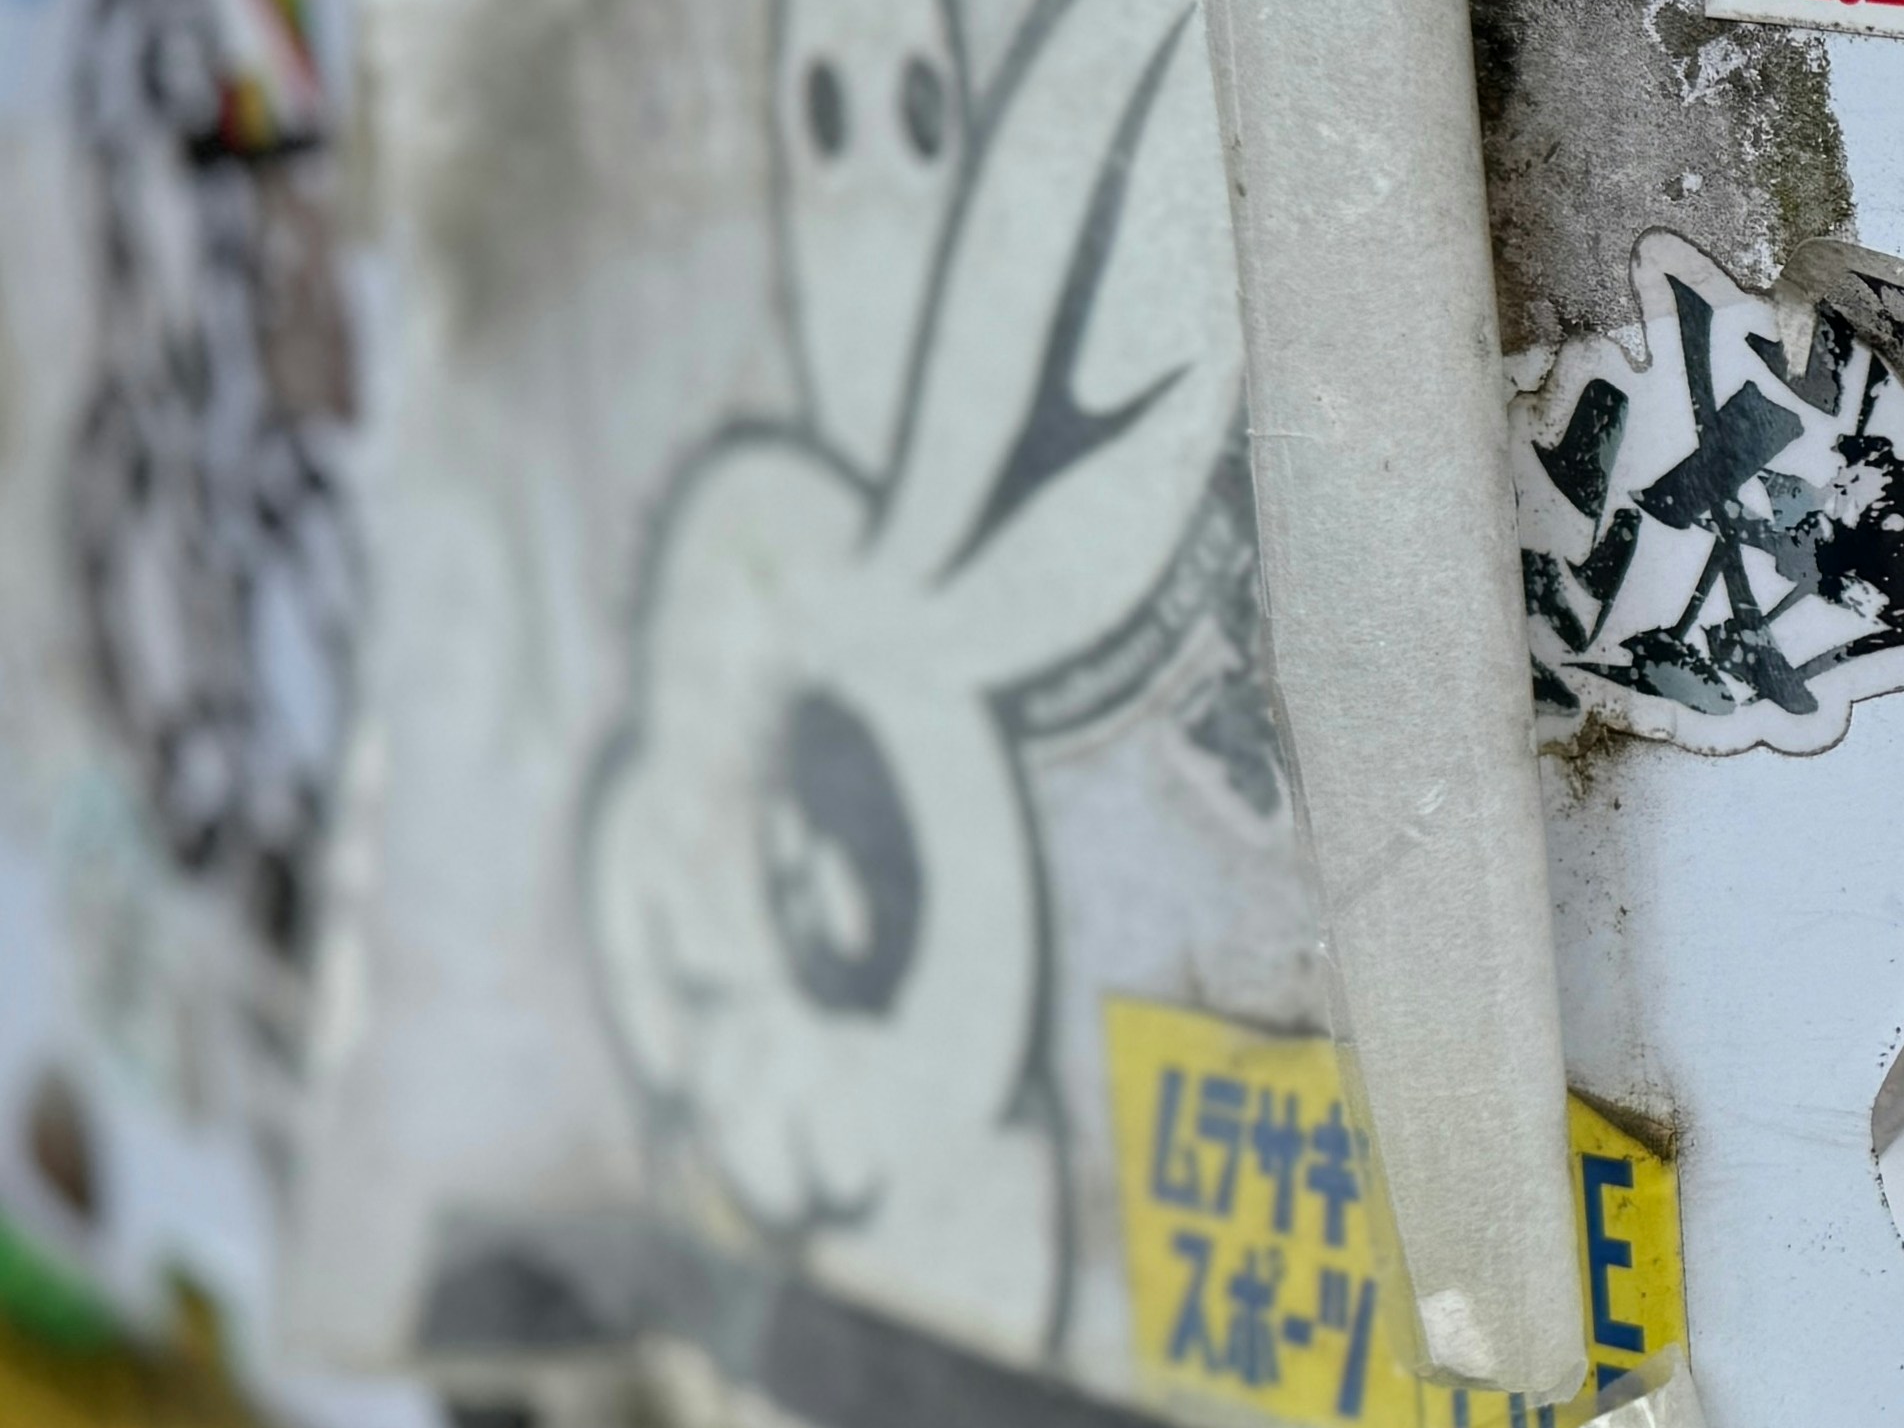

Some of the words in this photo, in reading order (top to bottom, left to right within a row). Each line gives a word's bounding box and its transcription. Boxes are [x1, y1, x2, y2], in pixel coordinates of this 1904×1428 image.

[1149, 1068, 1366, 1248] ムラサキ
[1166, 1229, 1379, 1420] スポーツ
